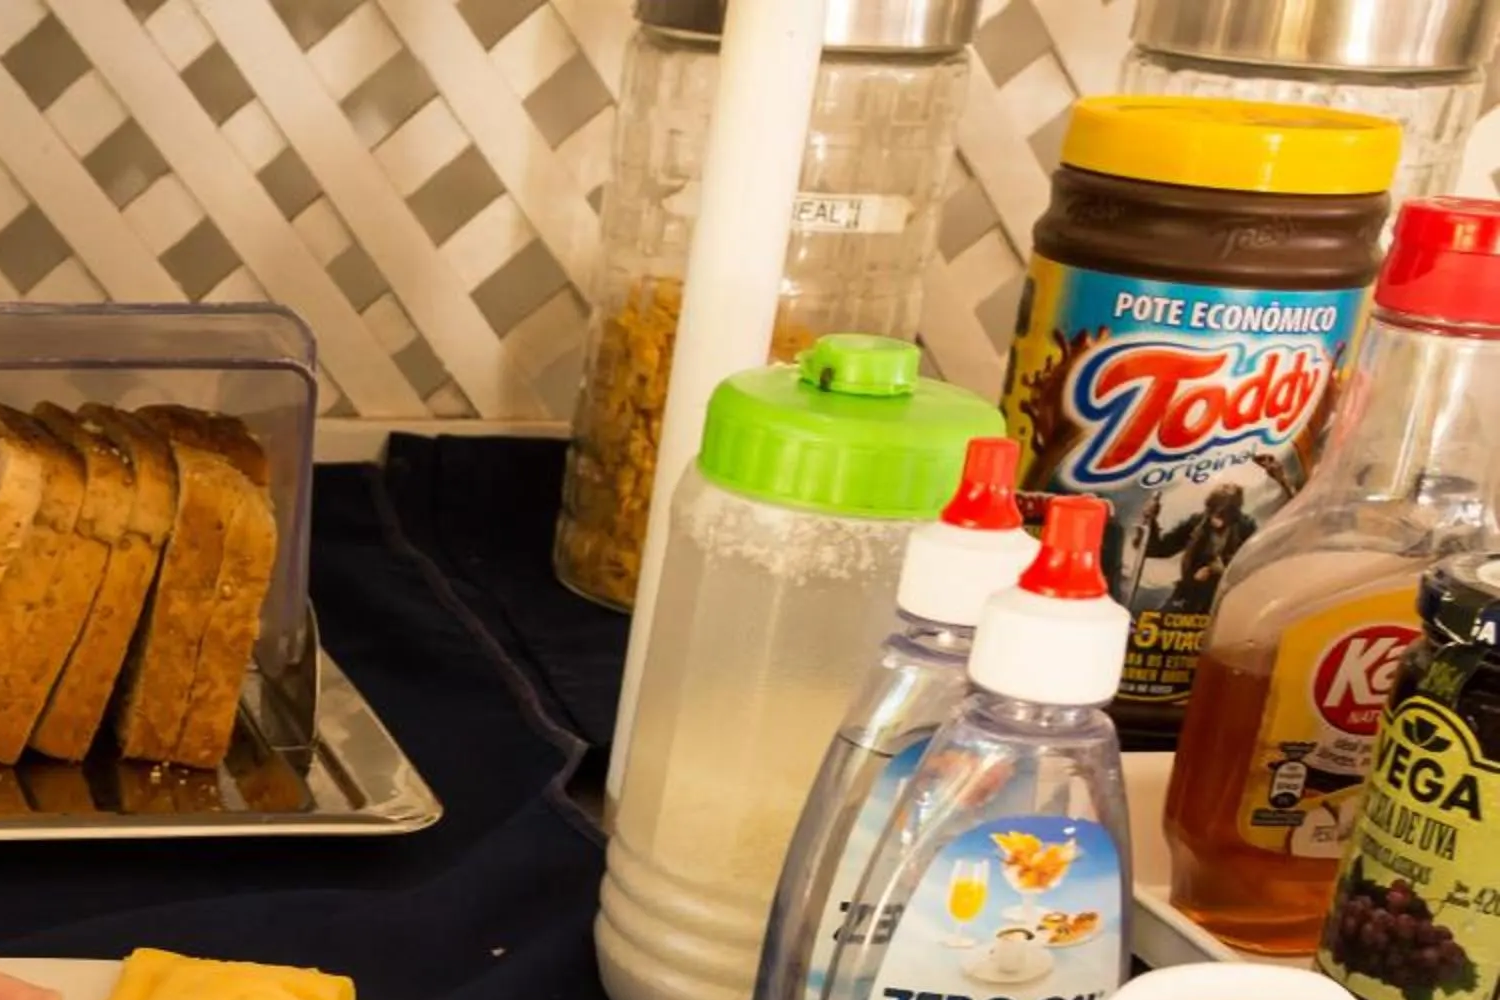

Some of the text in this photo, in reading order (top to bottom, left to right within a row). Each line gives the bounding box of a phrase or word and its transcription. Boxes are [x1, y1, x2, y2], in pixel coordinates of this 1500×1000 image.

[1113, 292, 1338, 333] POTE ECONÔMICO
[1092, 346, 1321, 470] Toddy
[1133, 610, 1162, 648] 5
